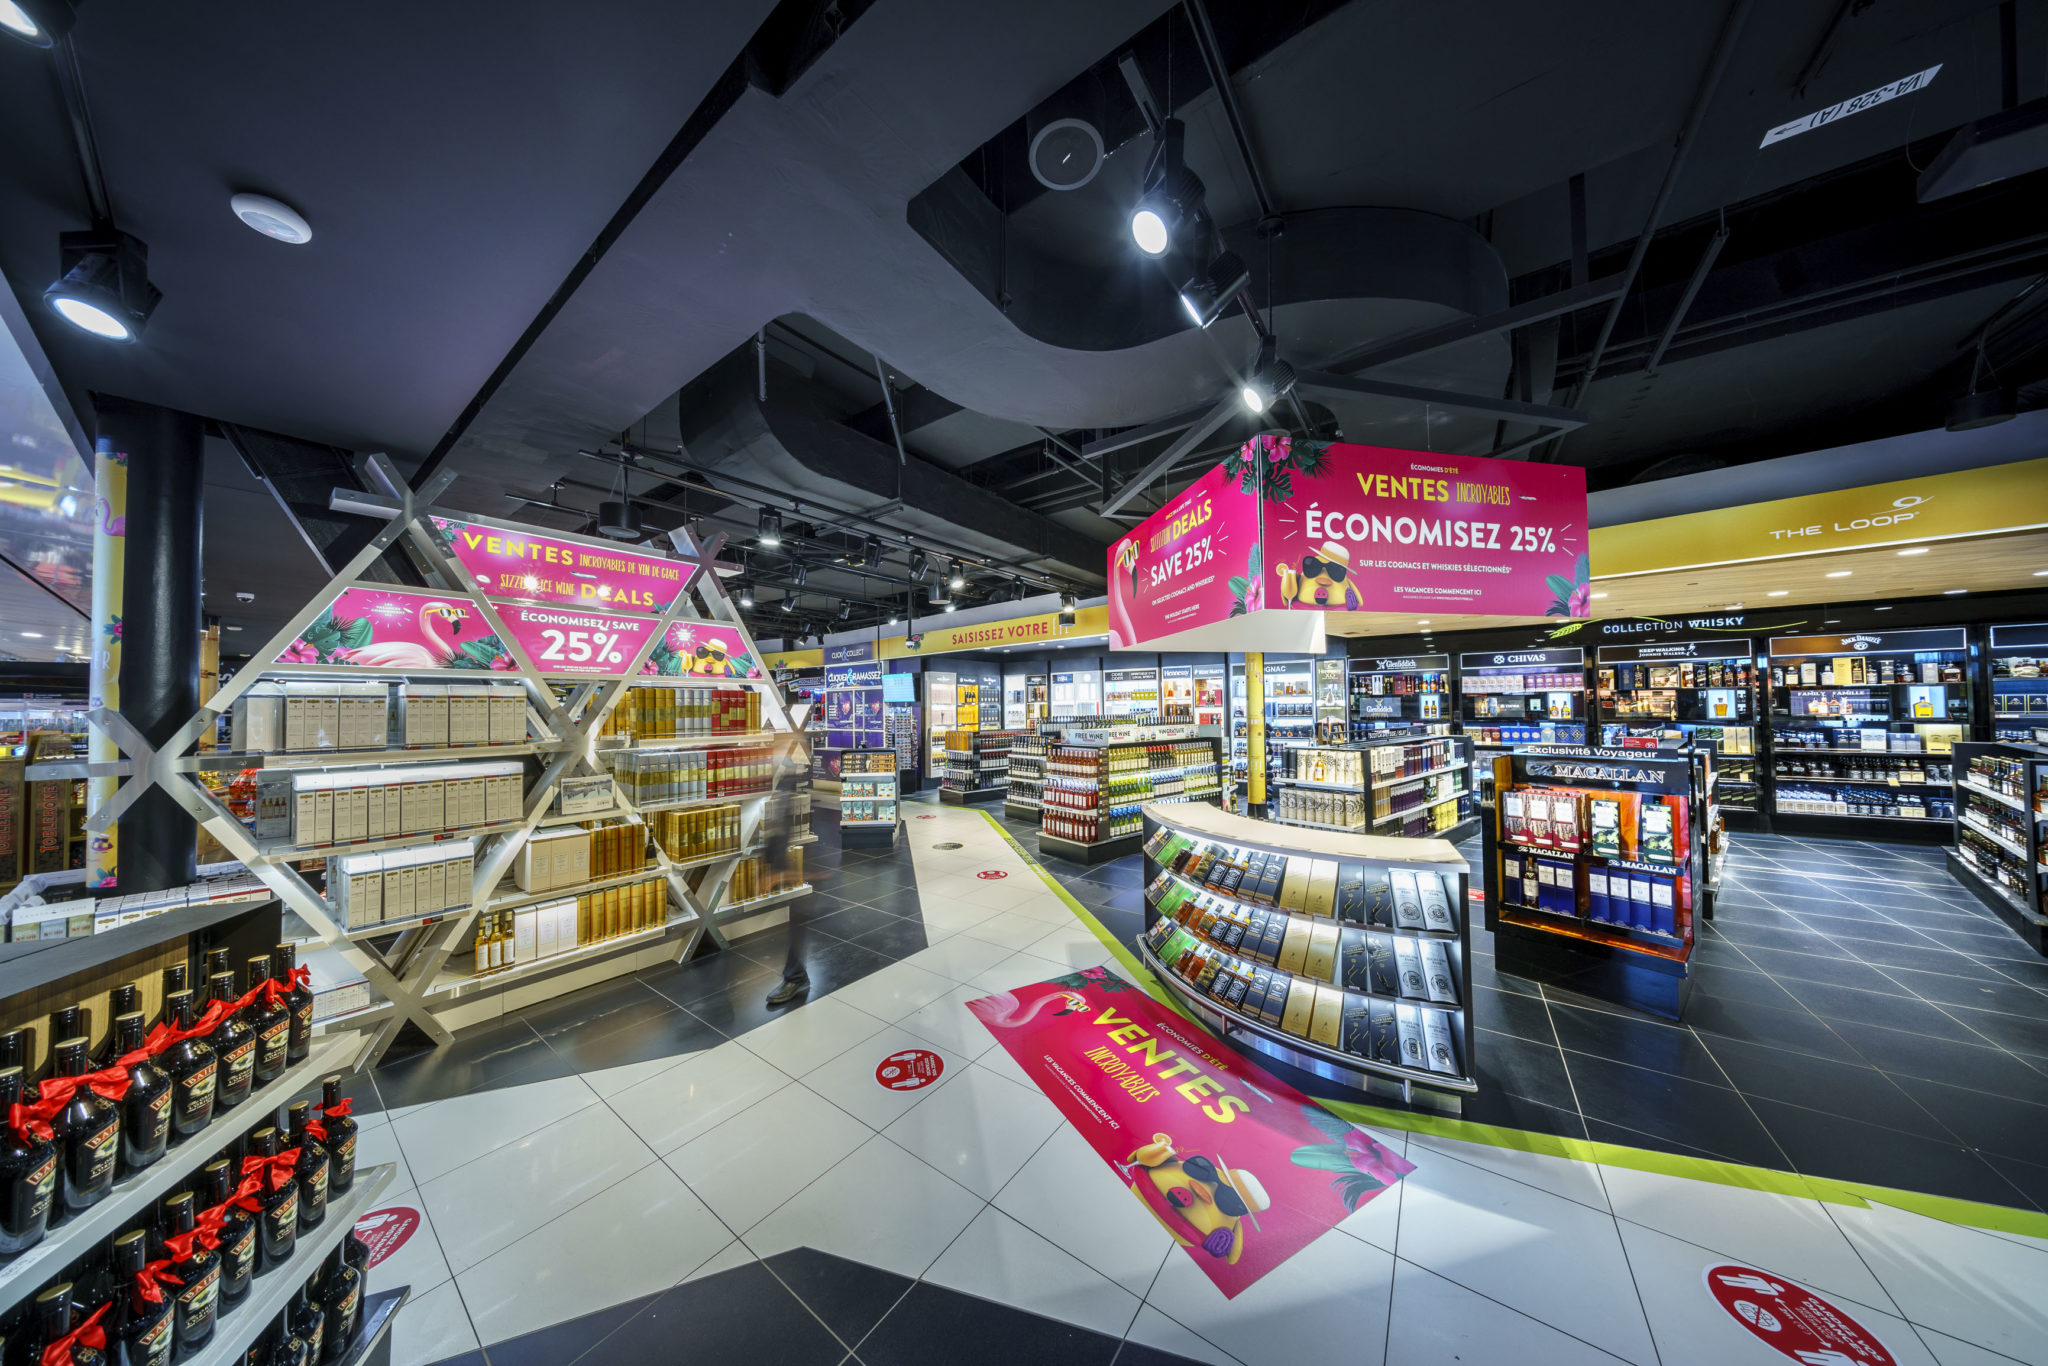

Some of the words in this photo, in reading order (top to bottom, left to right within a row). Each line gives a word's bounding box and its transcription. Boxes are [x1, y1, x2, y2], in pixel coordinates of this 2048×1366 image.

[1846, 71, 1922, 114] VA-328
[1809, 102, 1844, 127] (A)
[1410, 463, 1444, 473] ÉCONOMIES
[1356, 472, 1449, 502] VENTES
[1456, 482, 1511, 506] INCROYABLES
[1173, 498, 1212, 541] DEALS
[1305, 501, 1501, 549] ÉCONOMISEZ
[1509, 526, 1556, 553] 25%
[1769, 525, 1823, 539] THE
[1834, 512, 1915, 532] LOOP
[463, 531, 574, 566] VENTES
[579, 554, 626, 573] INCROYABLES
[627, 562, 636, 574] DE
[638, 563, 651, 576] VIN
[651, 565, 660, 578] DE
[1150, 551, 1183, 587] SAVE
[1185, 535, 1214, 572] 25%
[1359, 559, 1374, 567] SUR
[1375, 559, 1387, 568] LES
[1387, 560, 1421, 570] COGNACS
[1422, 562, 1430, 570] ET
[1430, 563, 1463, 572] WHISKIES
[555, 580, 575, 596] WINE
[580, 583, 654, 607] DEALS
[1170, 586, 1187, 598] COGNACS
[1404, 586, 1434, 594] VACANCES
[520, 610, 604, 629] ÉCONOMISEZ
[612, 620, 640, 631] SAVE
[952, 627, 1004, 645] SAISISSEZ
[1007, 621, 1048, 638] VOTRE
[1602, 621, 1683, 634] COLLECTION
[1687, 616, 1745, 628] WHISKY
[539, 628, 623, 664] 25%
[1507, 653, 1546, 663] CHIVAS
[1264, 665, 1287, 673] GNAC
[1385, 659, 1417, 668] Glenfiddich
[1075, 732, 1089, 740] FREE
[1527, 745, 1591, 757] Exclusivité
[1593, 747, 1658, 760] Voyageur
[1554, 765, 1666, 784] MACALLAN
[40, 784, 60, 854] TOBLERONE
[1528, 847, 1575, 860] MACALLAN
[1621, 860, 1678, 875] MACALLAN
[1156, 1021, 1204, 1056] ÉCONOMIES
[1201, 1052, 1230, 1072] D'ÉTÉ
[1083, 1044, 1161, 1103] INCROYABLES
[1092, 1006, 1251, 1124] VENTES
[1043, 1054, 1054, 1063] LES
[1052, 1061, 1077, 1086] VACANCES
[1073, 1084, 1112, 1121] COMMENCENT
[1108, 1120, 1121, 1130] ICI
[1801, 1300, 1869, 1357] DISTANCES
[1808, 1297, 1858, 1338] GARDEZ
[1857, 1339, 1886, 1362] VOS
